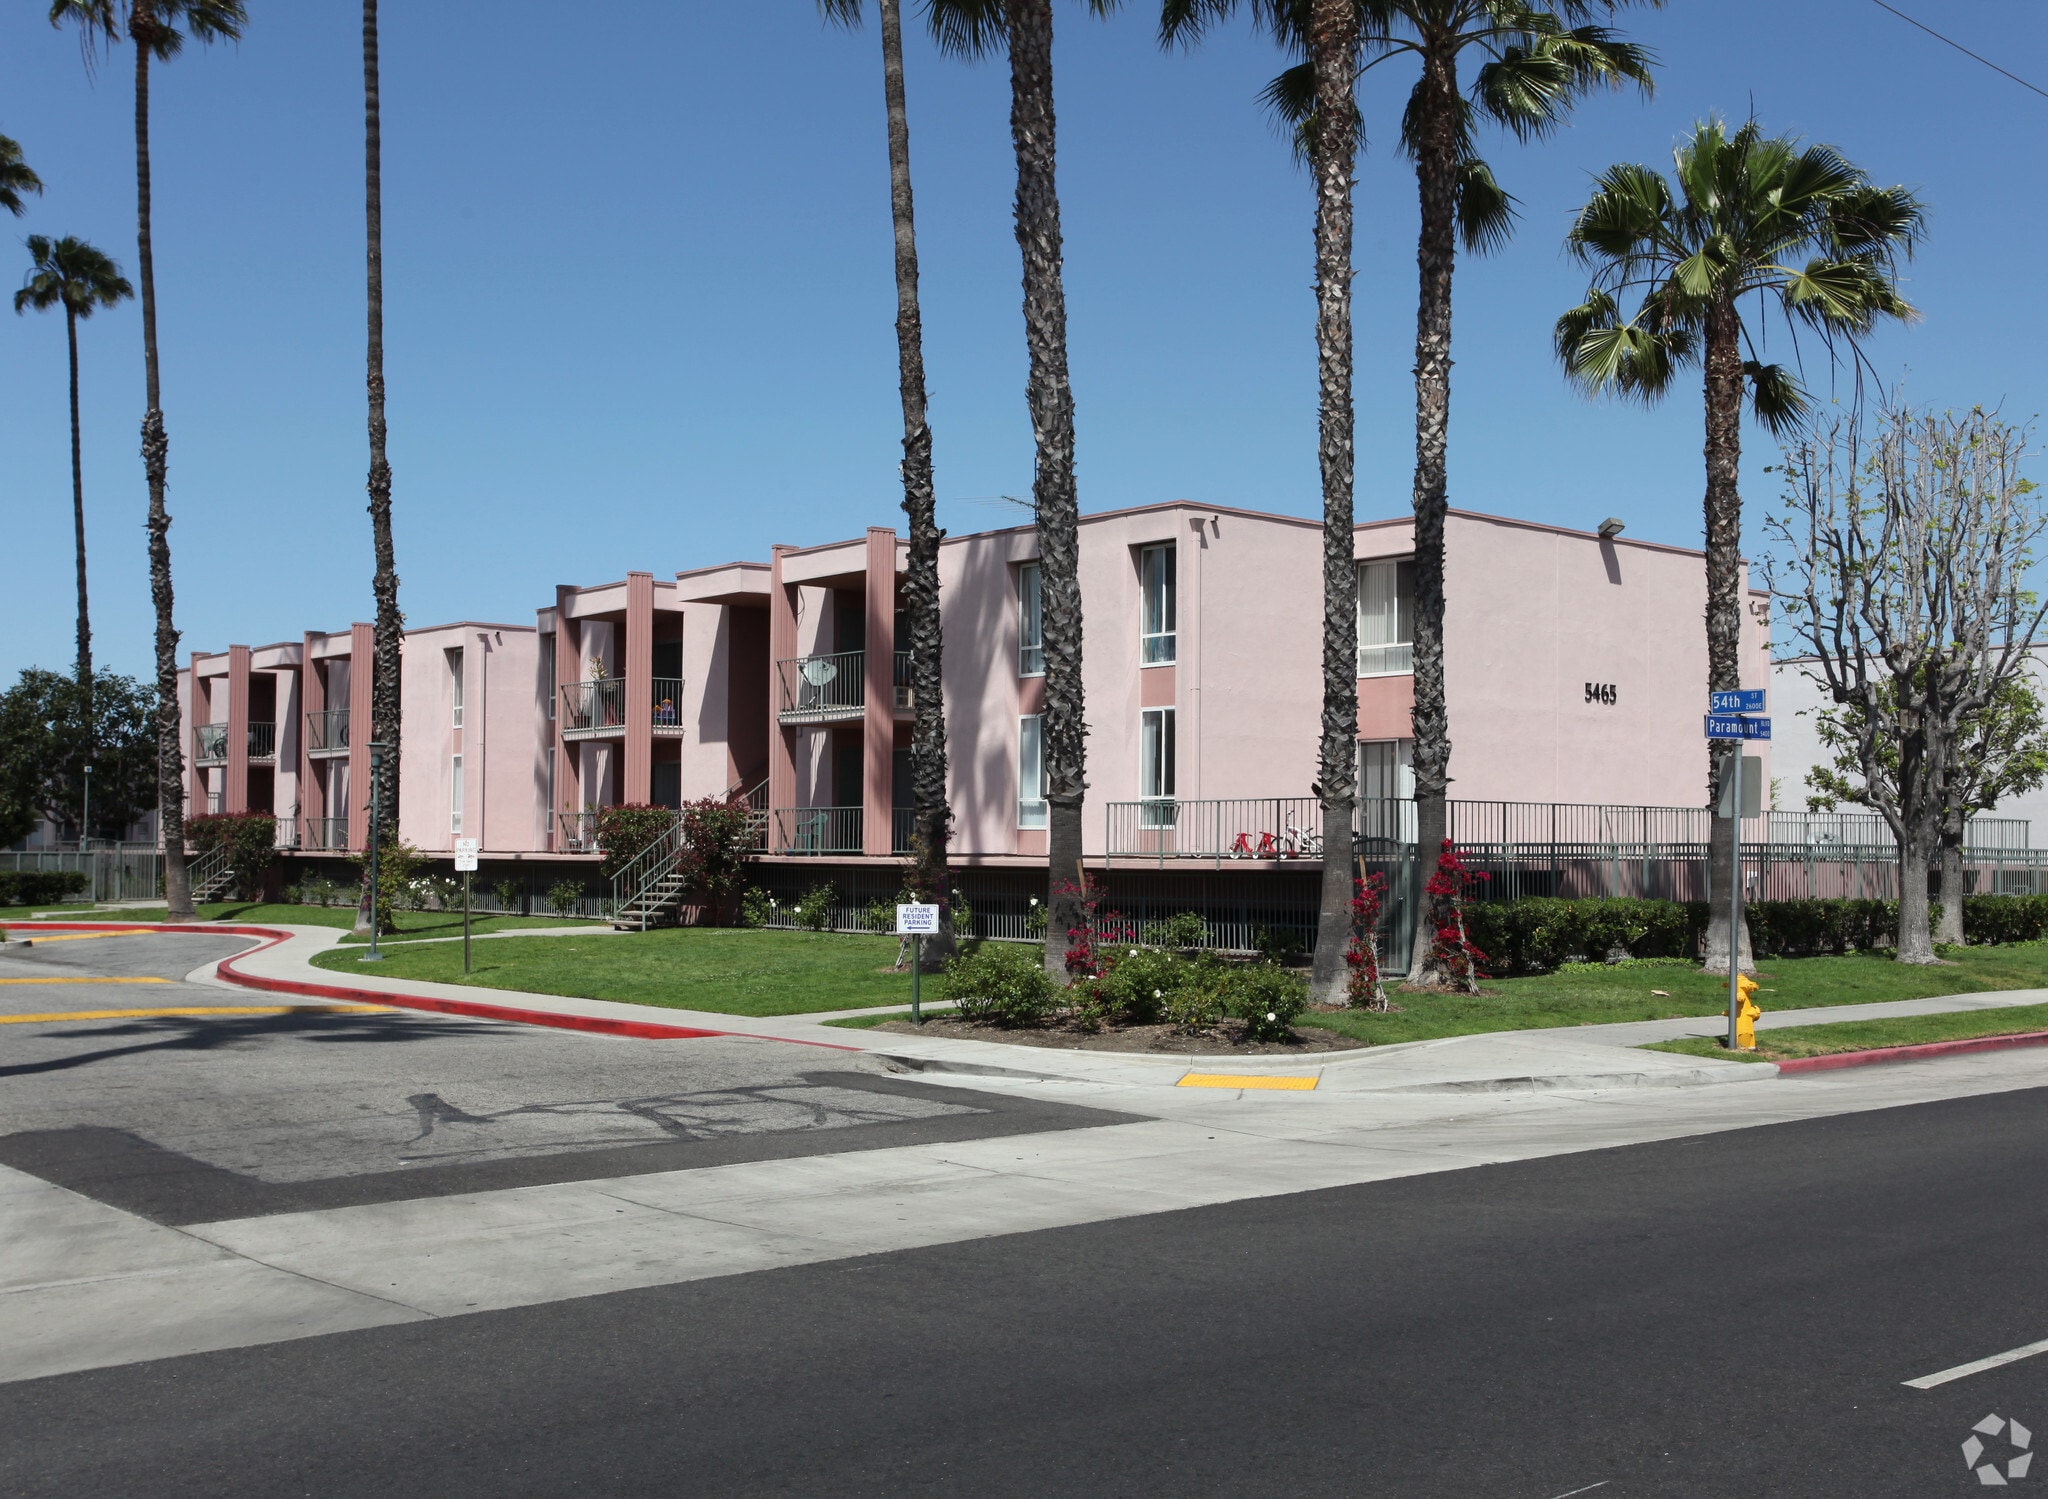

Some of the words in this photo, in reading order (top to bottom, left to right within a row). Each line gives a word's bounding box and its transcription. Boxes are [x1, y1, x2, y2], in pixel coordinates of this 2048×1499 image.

[1584, 682, 1617, 706] 5465
[1713, 694, 1740, 709] 54th
[1745, 702, 1762, 710] 2600E
[1709, 719, 1758, 734] Paramount
